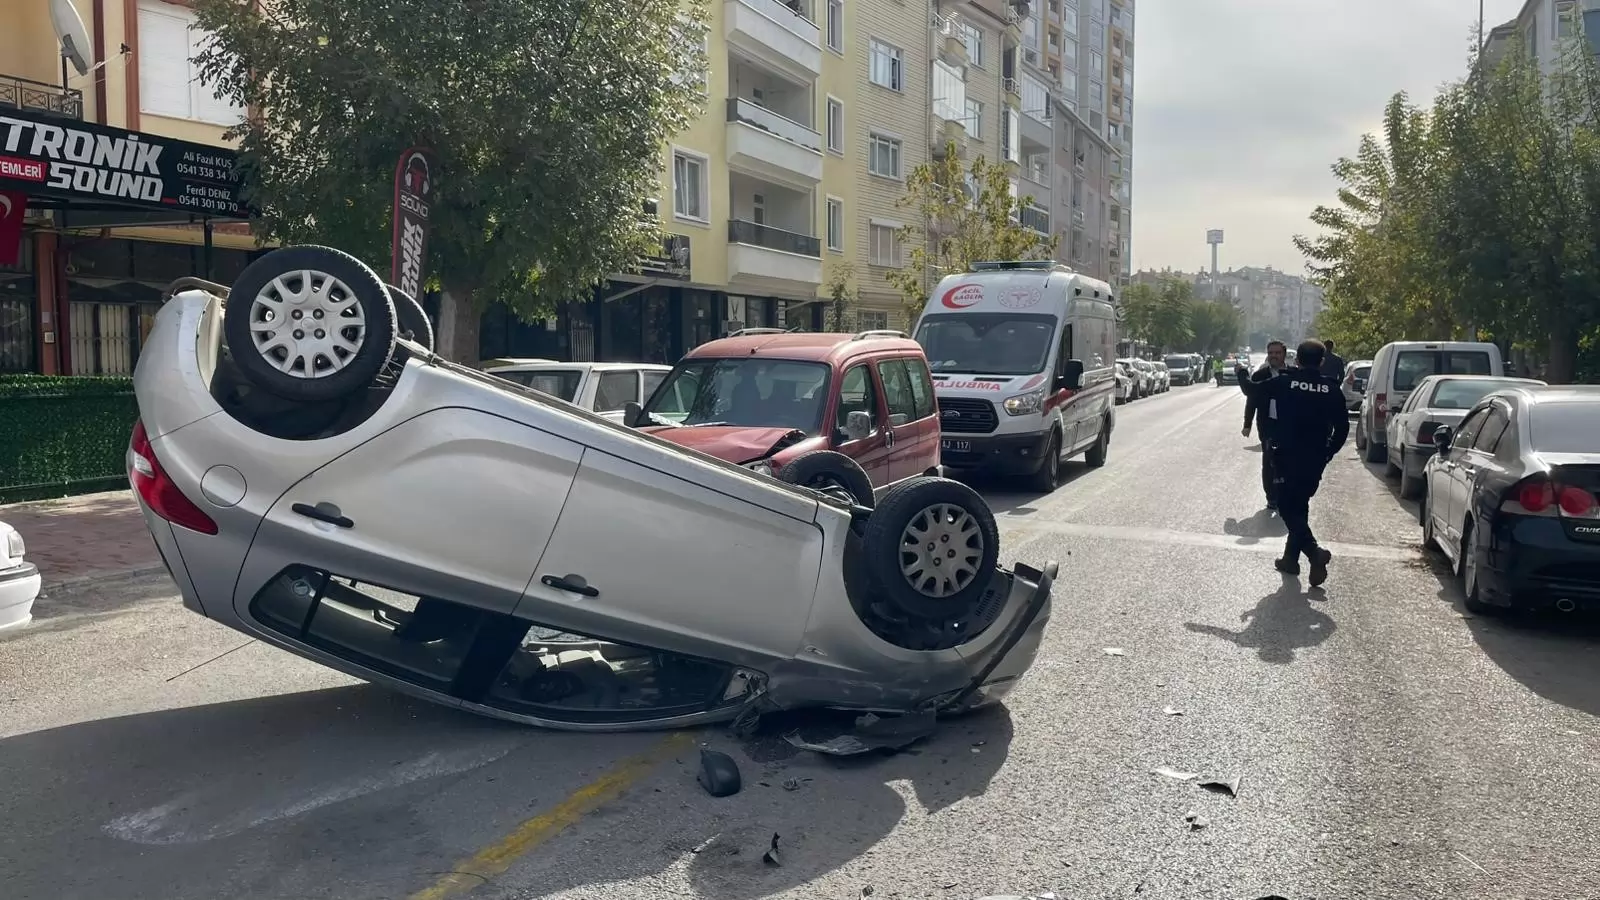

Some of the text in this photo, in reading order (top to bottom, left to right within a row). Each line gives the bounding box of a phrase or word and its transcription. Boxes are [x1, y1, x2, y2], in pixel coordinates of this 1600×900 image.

[183, 151, 195, 161] Ali
[196, 153, 214, 165] Fazıl
[176, 162, 197, 175] 0541
[199, 166, 214, 178] 338
[216, 169, 226, 180] 34
[47, 161, 164, 202] SOUND
[186, 184, 231, 200] Ferdi DENİZ
[178, 194, 239, 212] 0541 301 10 70
[401, 215, 416, 293] ONİK
[409, 223, 424, 299] OUND
[956, 440, 969, 449] 117
